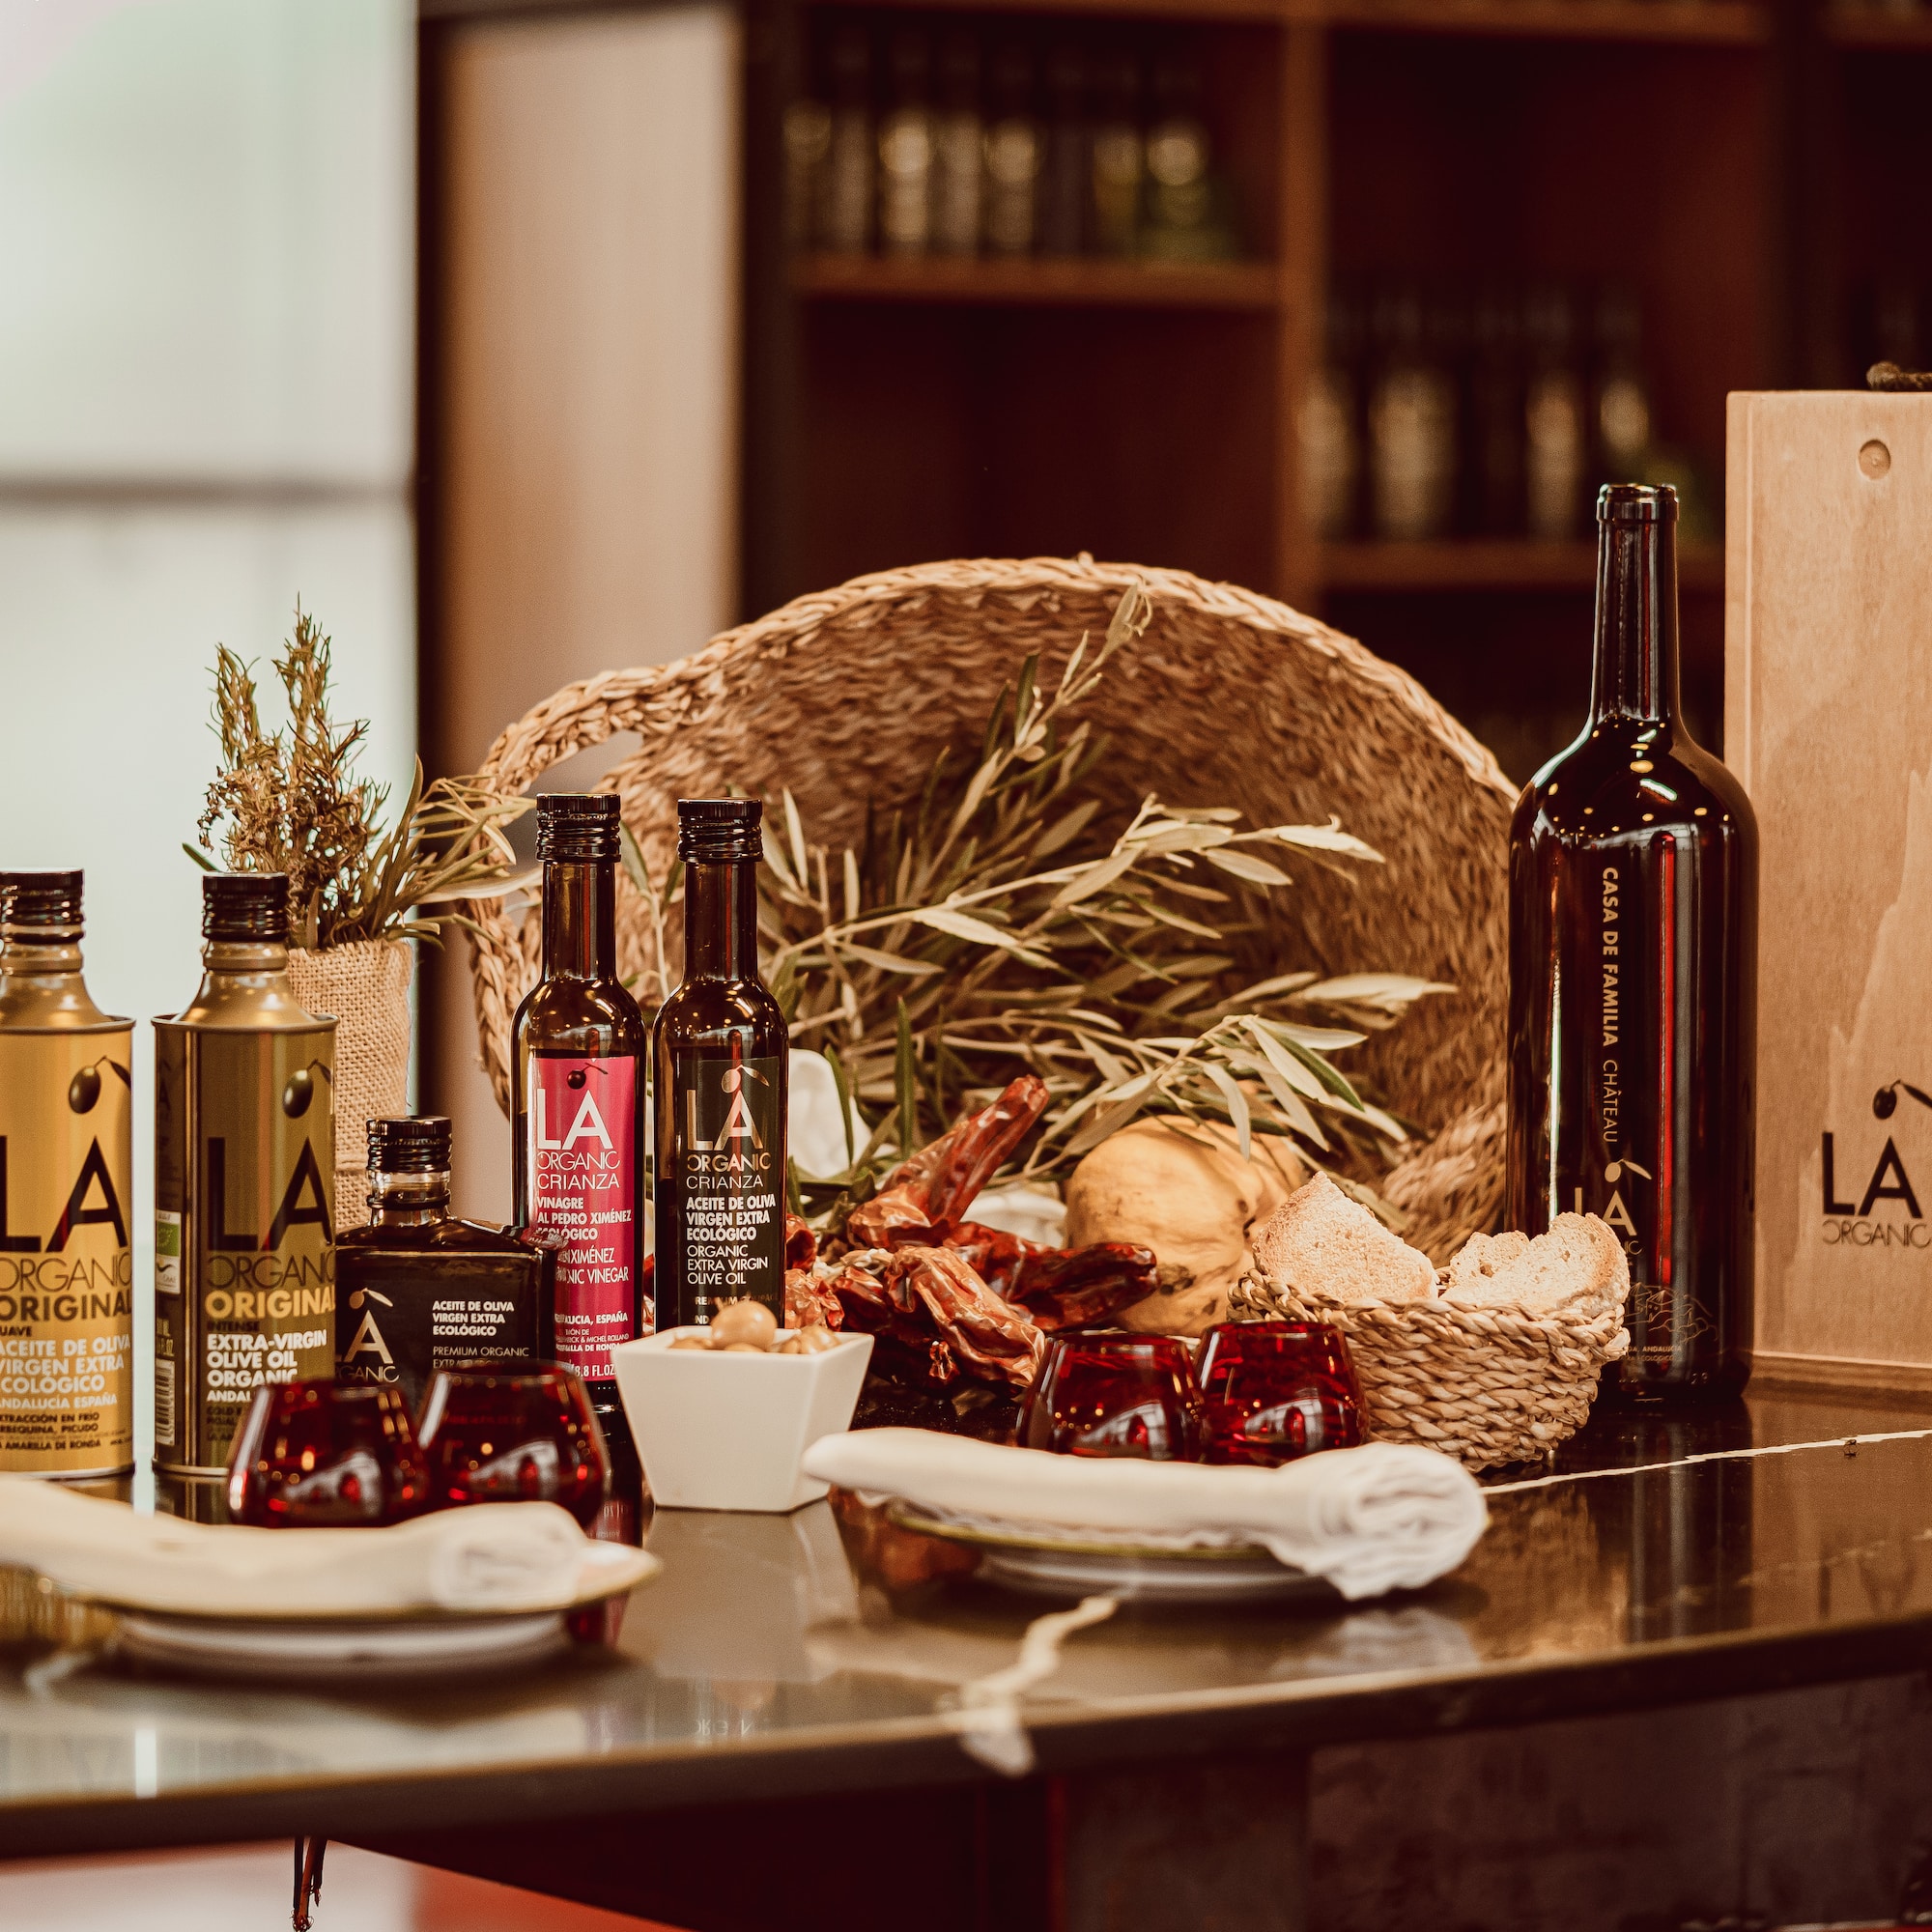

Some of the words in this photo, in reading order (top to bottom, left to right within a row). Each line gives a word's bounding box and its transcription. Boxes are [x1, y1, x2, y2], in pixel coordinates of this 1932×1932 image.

[1603, 867, 1618, 923] CASA
[1603, 931, 1618, 955] DE
[1603, 964, 1618, 1046] FAMILIA
[1603, 1059, 1622, 1143] CHÂTEAU
[537, 1089, 613, 1150] LA
[687, 1090, 763, 1151] LA
[537, 1151, 620, 1171] ORGANIC
[687, 1152, 771, 1172] ORGANIC
[537, 1173, 619, 1190] CRIANZA
[686, 1175, 763, 1189] CRIANZA
[1822, 1132, 1922, 1219] LA
[209, 1136, 332, 1252] LA
[537, 1196, 583, 1208] VINAGRE
[686, 1197, 724, 1210] ACEITE
[728, 1197, 744, 1210] DE
[747, 1194, 776, 1209] OLIVA
[537, 1212, 549, 1224] AL
[552, 1212, 587, 1224] PEDRO
[590, 1208, 631, 1224] XIMÉNEZ
[686, 1212, 732, 1226] VIRGEN
[736, 1210, 770, 1225] EXTRA
[687, 1225, 756, 1241] ECOLÓGICO
[1822, 1219, 1931, 1249] ORGANIC
[570, 1245, 615, 1264] XIMÉNEZ
[687, 1245, 749, 1258] ORGANIC
[688, 1259, 725, 1271] EXTRA
[727, 1257, 768, 1270] VIRGIN
[586, 1266, 629, 1284] VINEGAR
[687, 1272, 723, 1285] OLIVE
[725, 1272, 746, 1285] OIL
[433, 1301, 466, 1312] ACEITE
[468, 1301, 481, 1312] DE
[483, 1301, 514, 1312] OLIVA
[433, 1314, 469, 1323] VIRGEN
[471, 1314, 505, 1324] EXTRA
[596, 1311, 629, 1324] ESPAÑA
[0, 1326, 32, 1337] UAVE
[433, 1323, 497, 1337] ECOLÓGICO
[63, 1339, 87, 1356] DE
[92, 1334, 130, 1353] OLIVA
[207, 1329, 327, 1350] EXTRA-VIRGIN
[207, 1350, 263, 1369] OLIVE
[267, 1350, 298, 1369] OIL
[433, 1346, 477, 1356] PREMIUM
[480, 1347, 529, 1357] ORGANIC
[75, 1353, 124, 1374] EXTRA
[0, 1373, 105, 1394] COLÓGICO
[0, 1394, 70, 1409] NDALUCÍA
[73, 1392, 117, 1408] ESPAÑA
